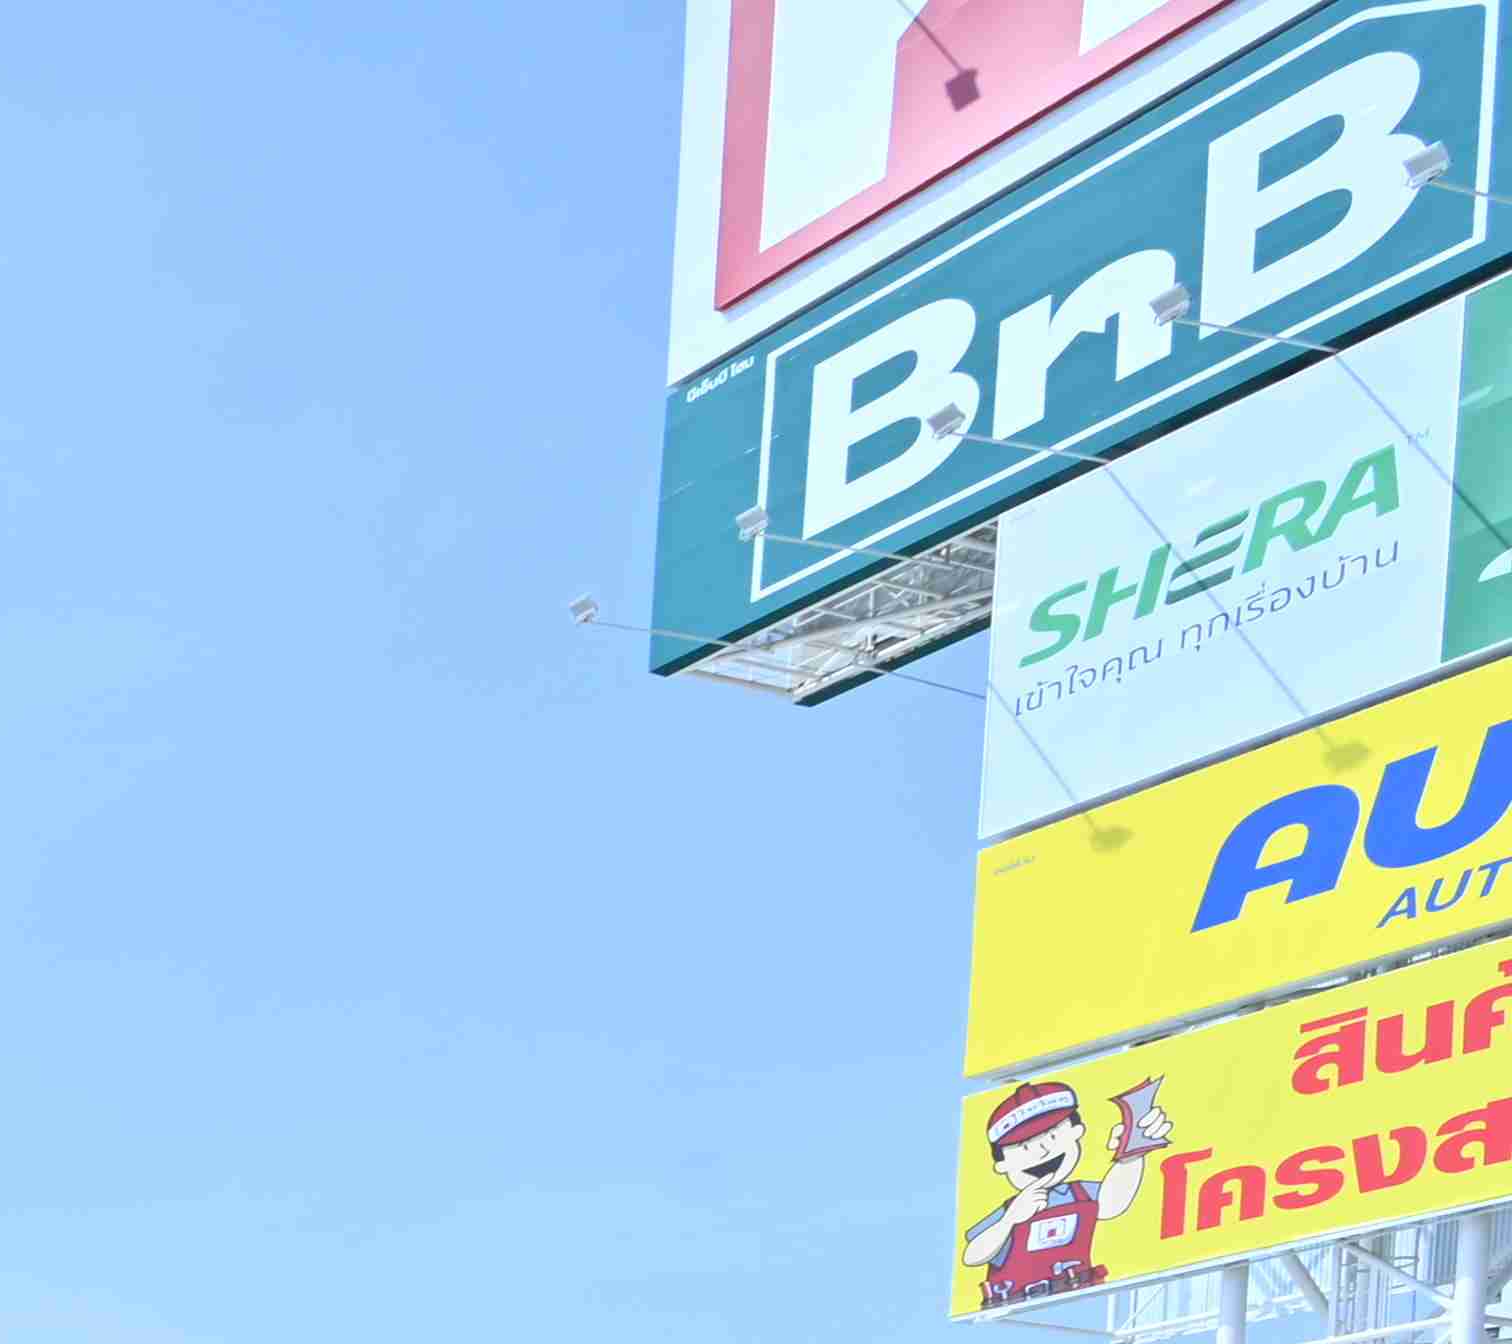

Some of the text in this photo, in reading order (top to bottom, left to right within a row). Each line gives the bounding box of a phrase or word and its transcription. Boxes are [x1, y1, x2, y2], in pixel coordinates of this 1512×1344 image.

[802, 51, 1429, 540] BnB
[1014, 541, 1400, 717] เข้าใจคุณ ทุกเรื่องบ้าน
[1017, 443, 1400, 668] SHERA
